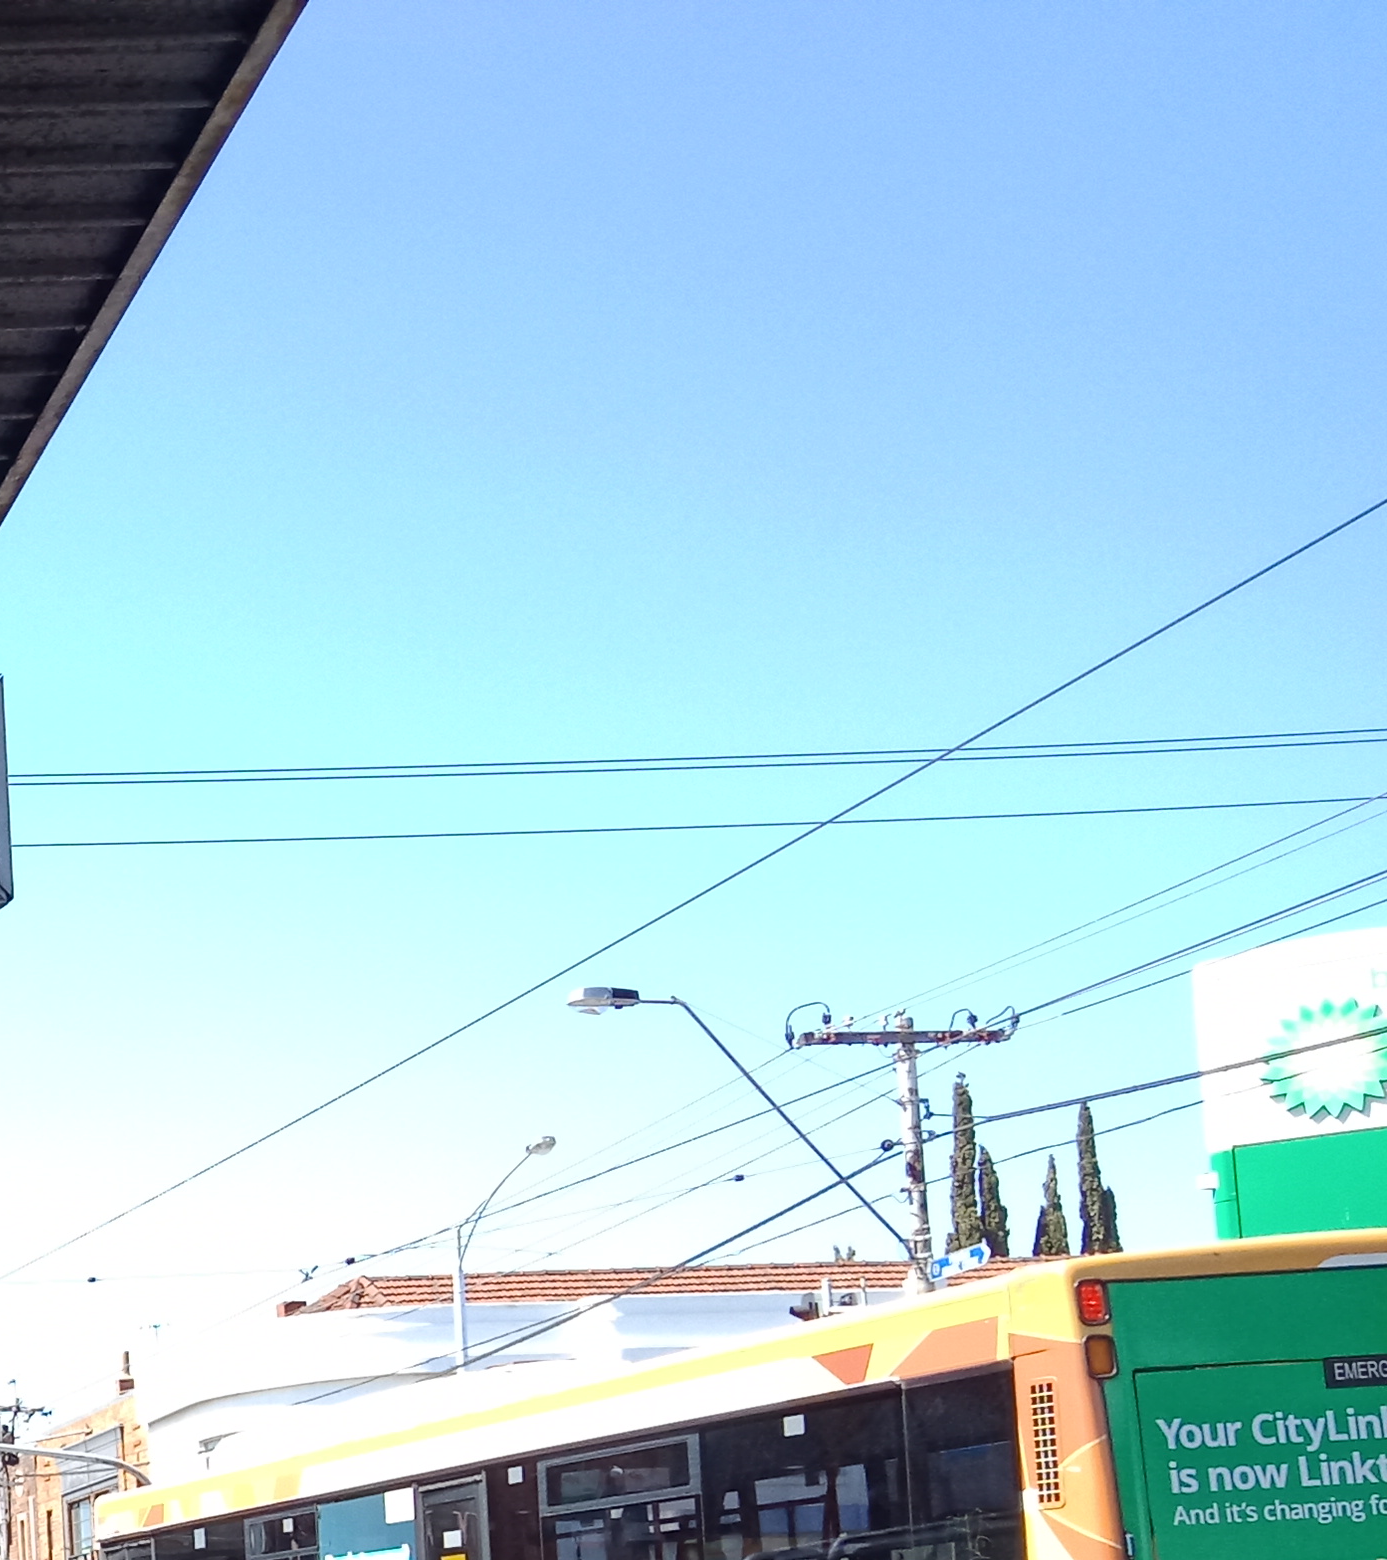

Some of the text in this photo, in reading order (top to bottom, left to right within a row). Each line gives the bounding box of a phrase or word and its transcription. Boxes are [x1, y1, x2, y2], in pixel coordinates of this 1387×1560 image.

[1155, 1417, 1243, 1450] Your
[1168, 1451, 1387, 1494] is now Linkt
[1173, 1502, 1221, 1526] And
[1225, 1500, 1258, 1523] it's
[1263, 1496, 1366, 1525] changing
